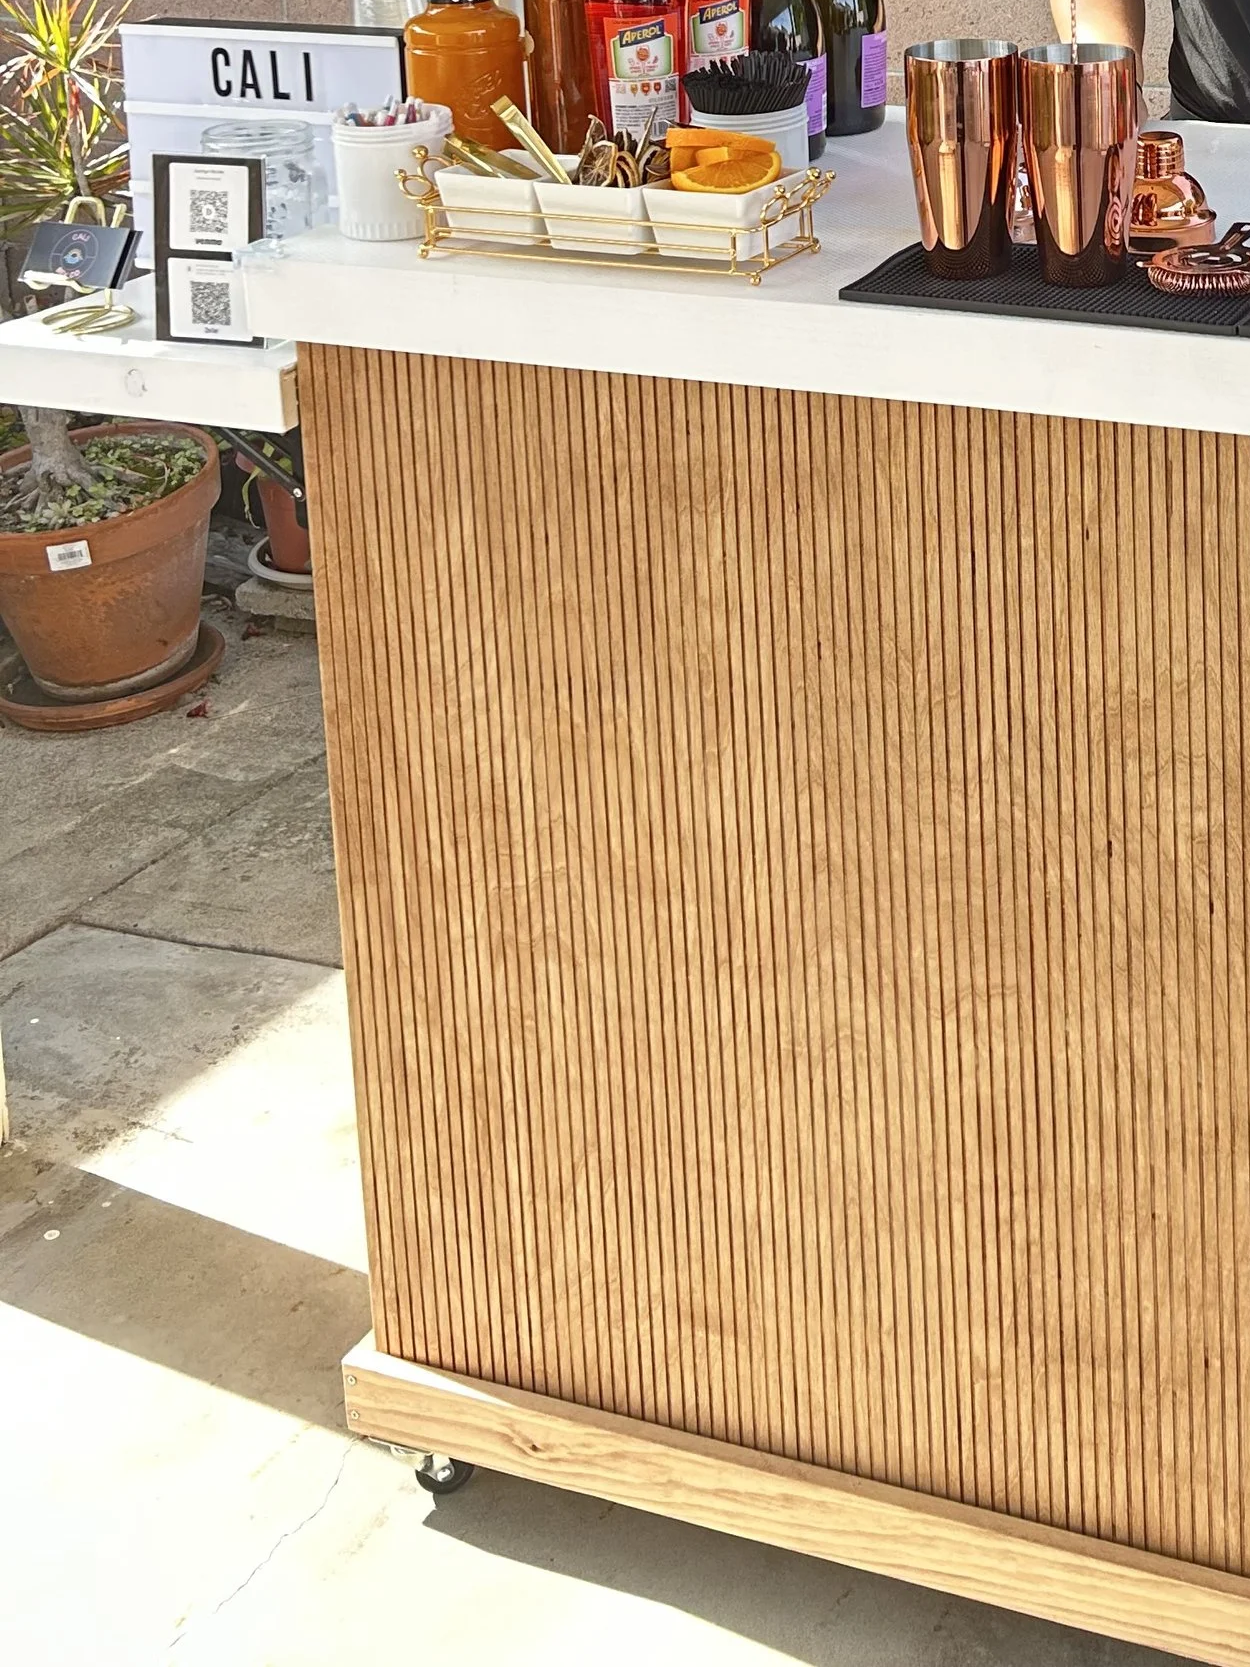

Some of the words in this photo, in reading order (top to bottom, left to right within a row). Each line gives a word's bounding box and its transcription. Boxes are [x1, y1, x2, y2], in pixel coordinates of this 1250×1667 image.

[702, 1, 738, 21] APEROL
[622, 25, 662, 45] APEROL
[211, 47, 314, 102] CALI
